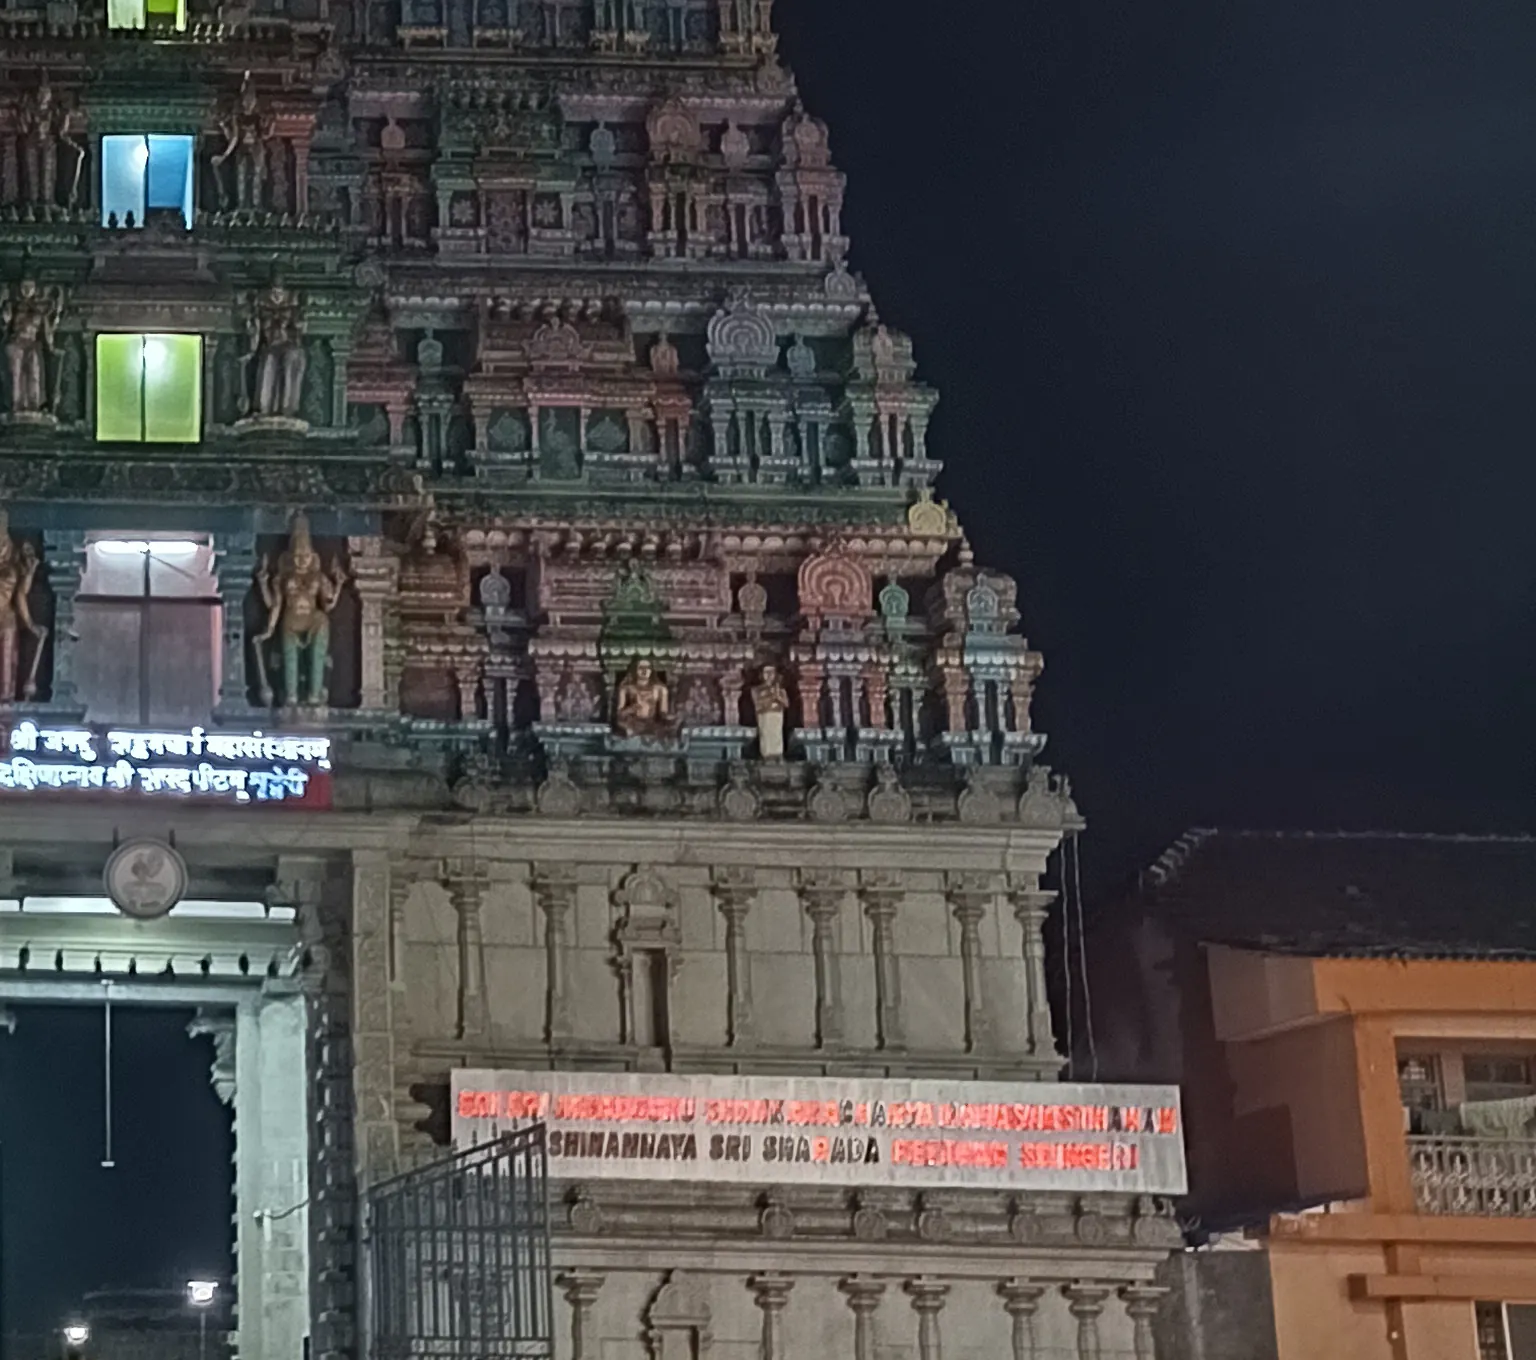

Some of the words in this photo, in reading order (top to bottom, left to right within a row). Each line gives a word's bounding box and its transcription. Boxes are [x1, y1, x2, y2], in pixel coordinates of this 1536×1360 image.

[10, 720, 38, 751] श्री
[105, 759, 136, 790] श्री
[457, 1090, 499, 1118] SRI
[506, 1091, 551, 1120] SRI
[708, 1133, 752, 1162] SRI
[762, 1135, 880, 1165] SHARADA
[1020, 1141, 1140, 1171] SRINGERI
